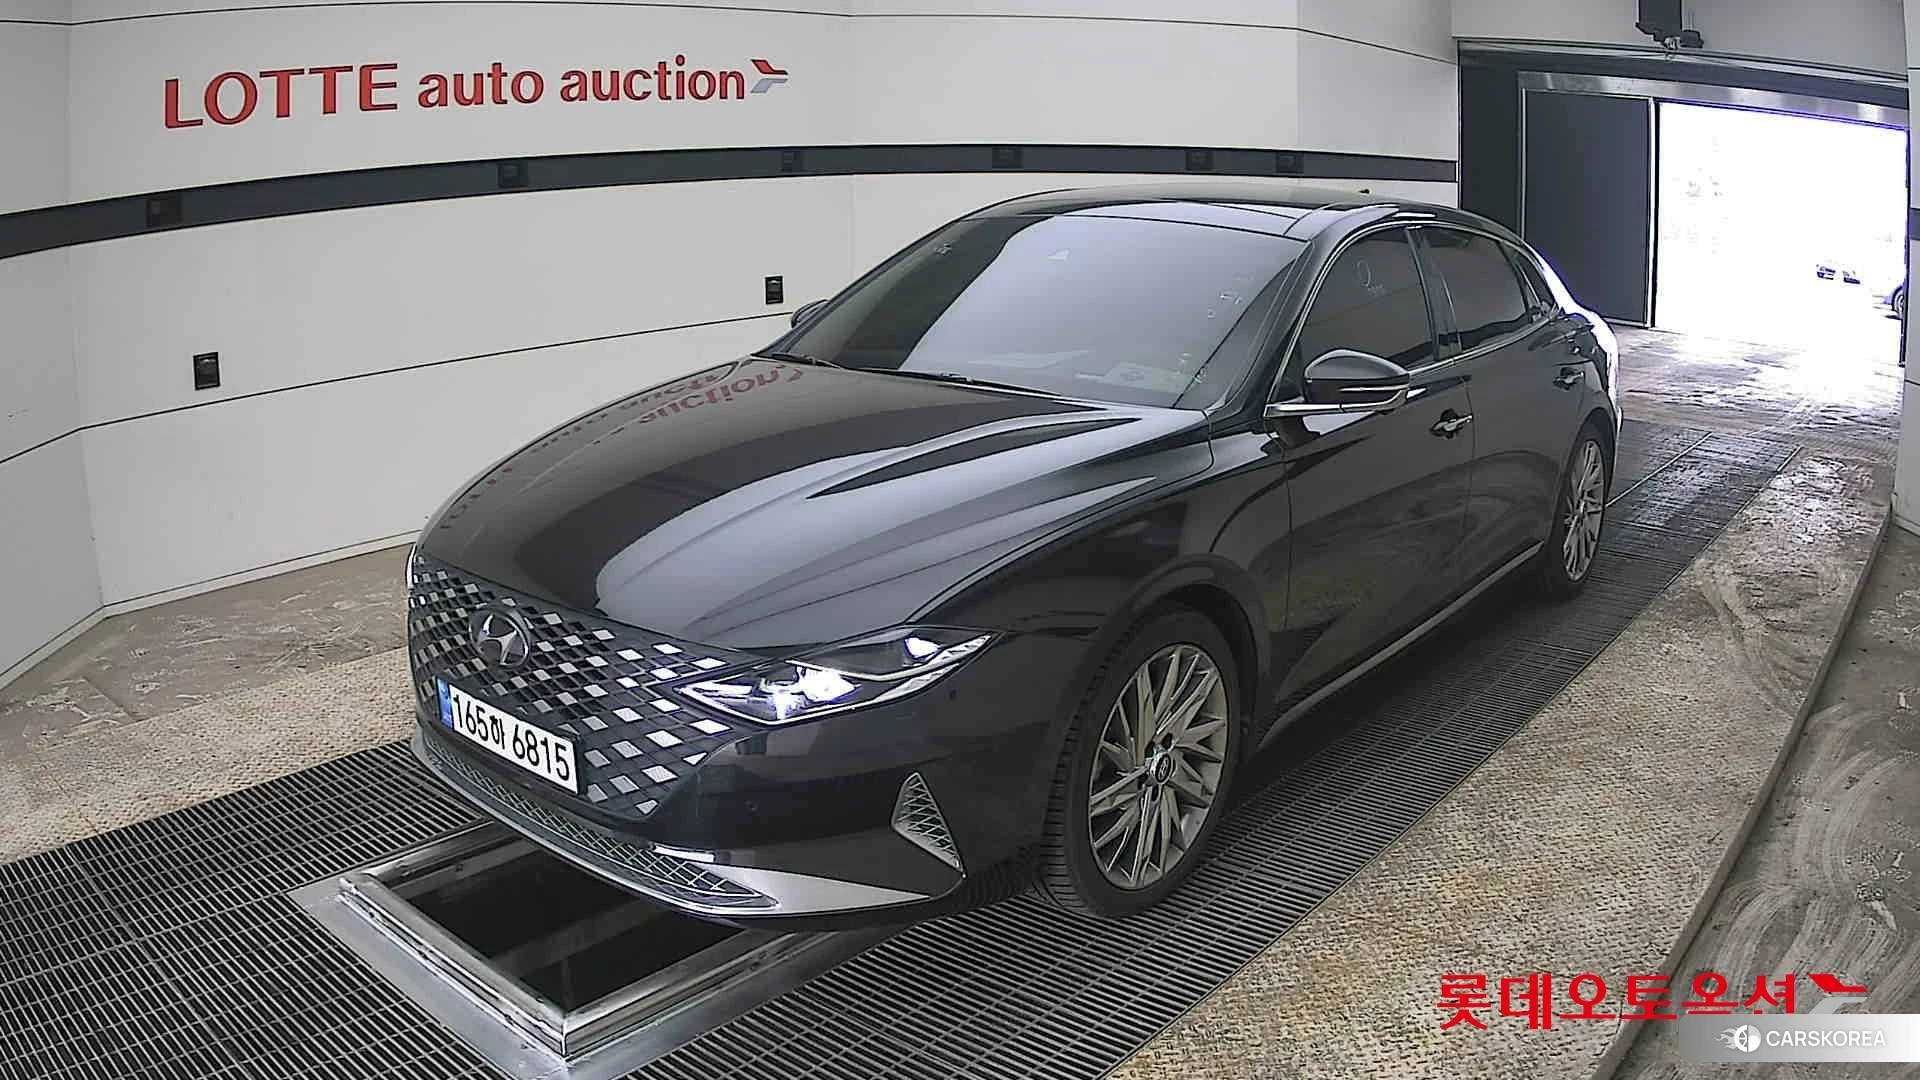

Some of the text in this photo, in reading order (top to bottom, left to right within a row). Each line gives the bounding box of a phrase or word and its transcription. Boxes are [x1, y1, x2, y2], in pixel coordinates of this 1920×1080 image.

[164, 55, 746, 129] LOTTE auto auction
[512, 724, 570, 781] 6815
